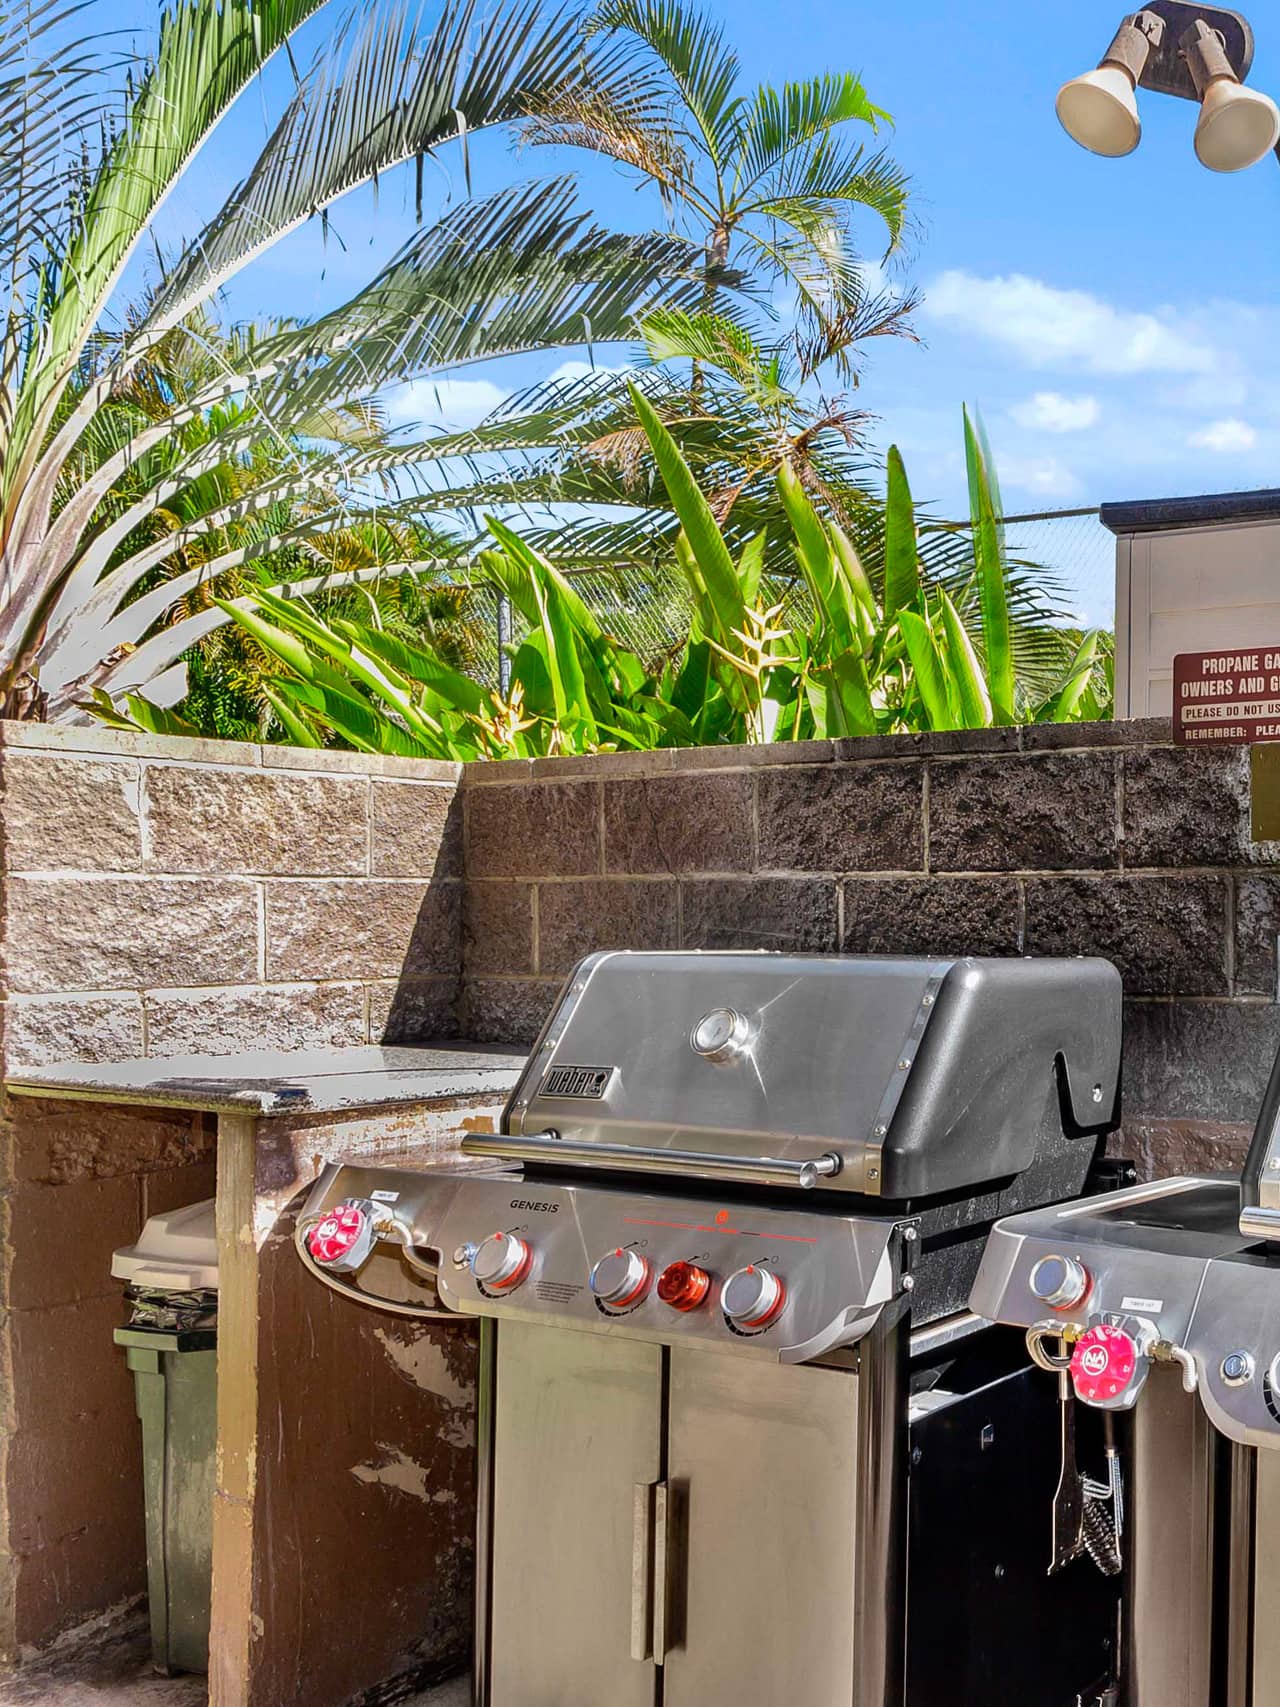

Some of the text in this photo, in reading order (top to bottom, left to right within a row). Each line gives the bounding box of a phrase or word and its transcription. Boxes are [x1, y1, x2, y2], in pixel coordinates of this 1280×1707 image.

[1202, 655, 1258, 674] PROPANE
[1181, 676, 1233, 698] OWNERS
[1239, 677, 1265, 694] AND
[1186, 705, 1222, 719] PLEASE
[1226, 705, 1240, 716] DO
[1244, 704, 1263, 715] NOT
[1185, 726, 1247, 740] REMEMBER:
[510, 1199, 560, 1213] GENESIS
